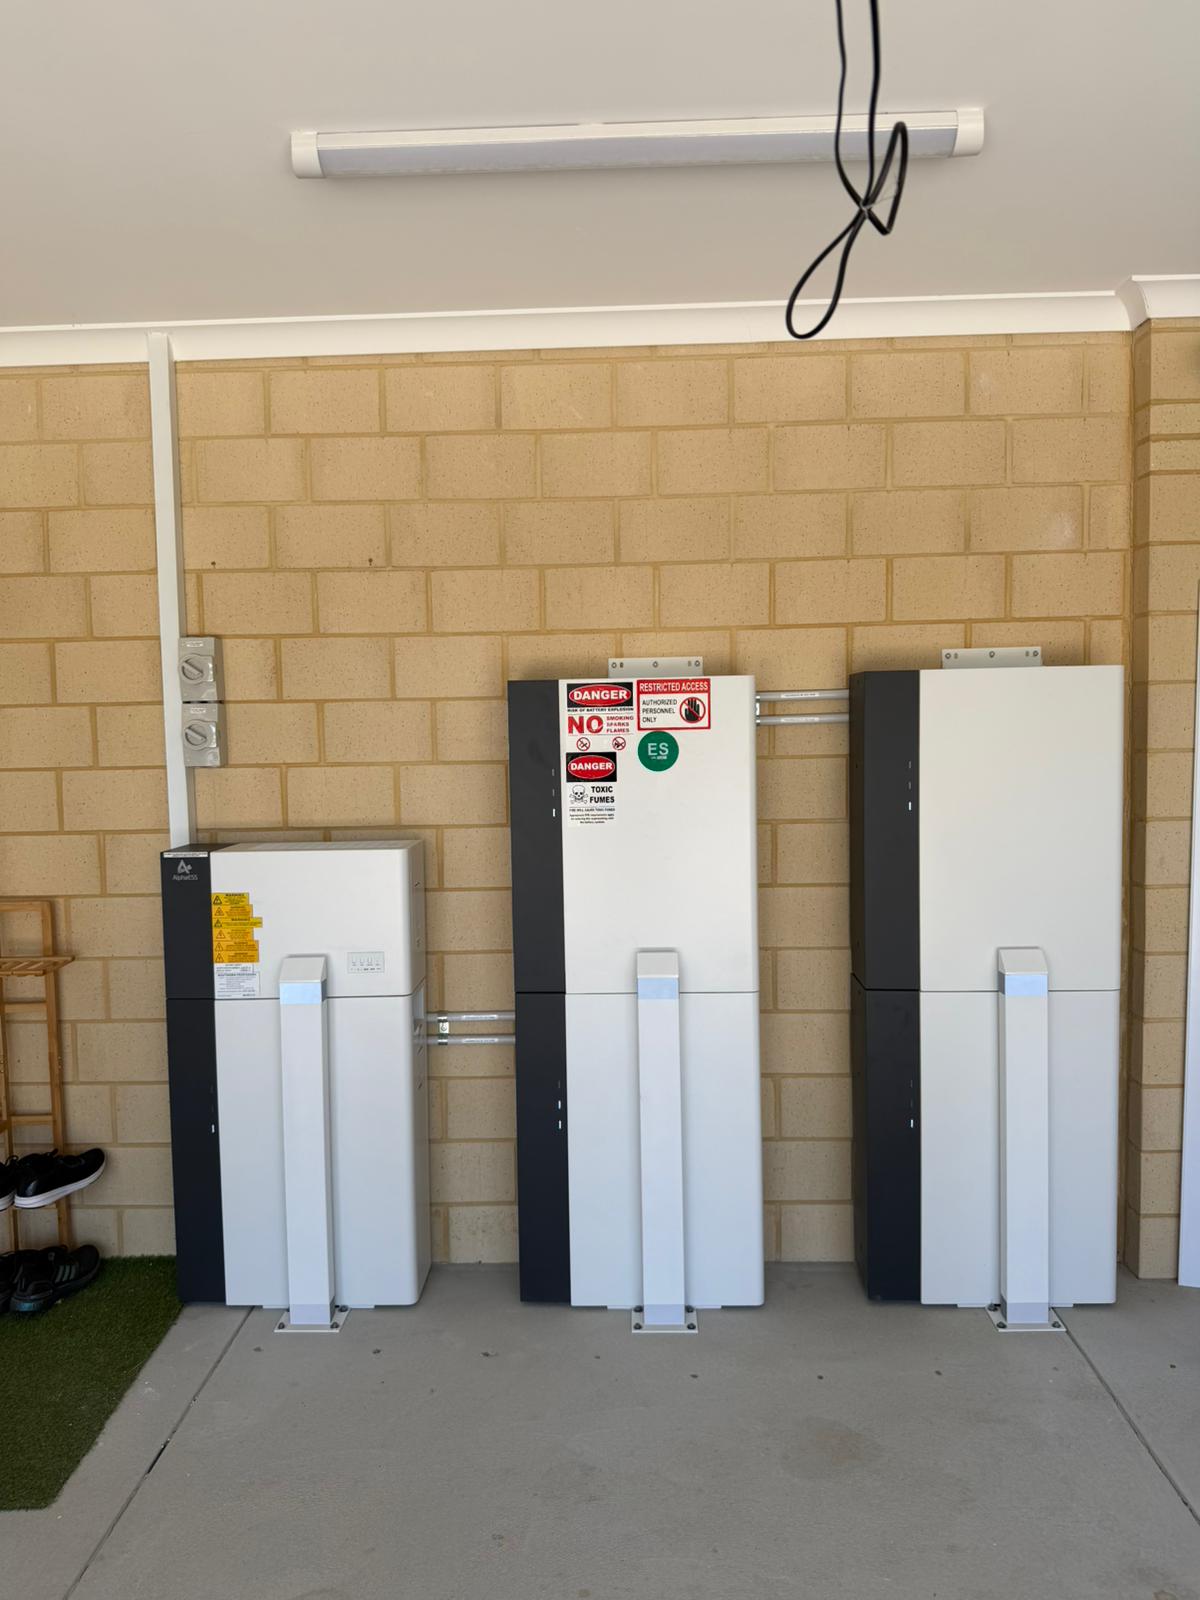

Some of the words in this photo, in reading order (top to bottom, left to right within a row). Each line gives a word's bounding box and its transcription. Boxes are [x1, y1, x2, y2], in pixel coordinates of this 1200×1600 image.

[639, 682, 680, 692] RESTRICTED
[681, 681, 709, 691] ACCESS
[573, 690, 628, 700] DANGER
[568, 715, 604, 734] NO
[647, 742, 669, 756] ES
[570, 762, 613, 770] DANGER
[590, 796, 615, 804] FUMES
